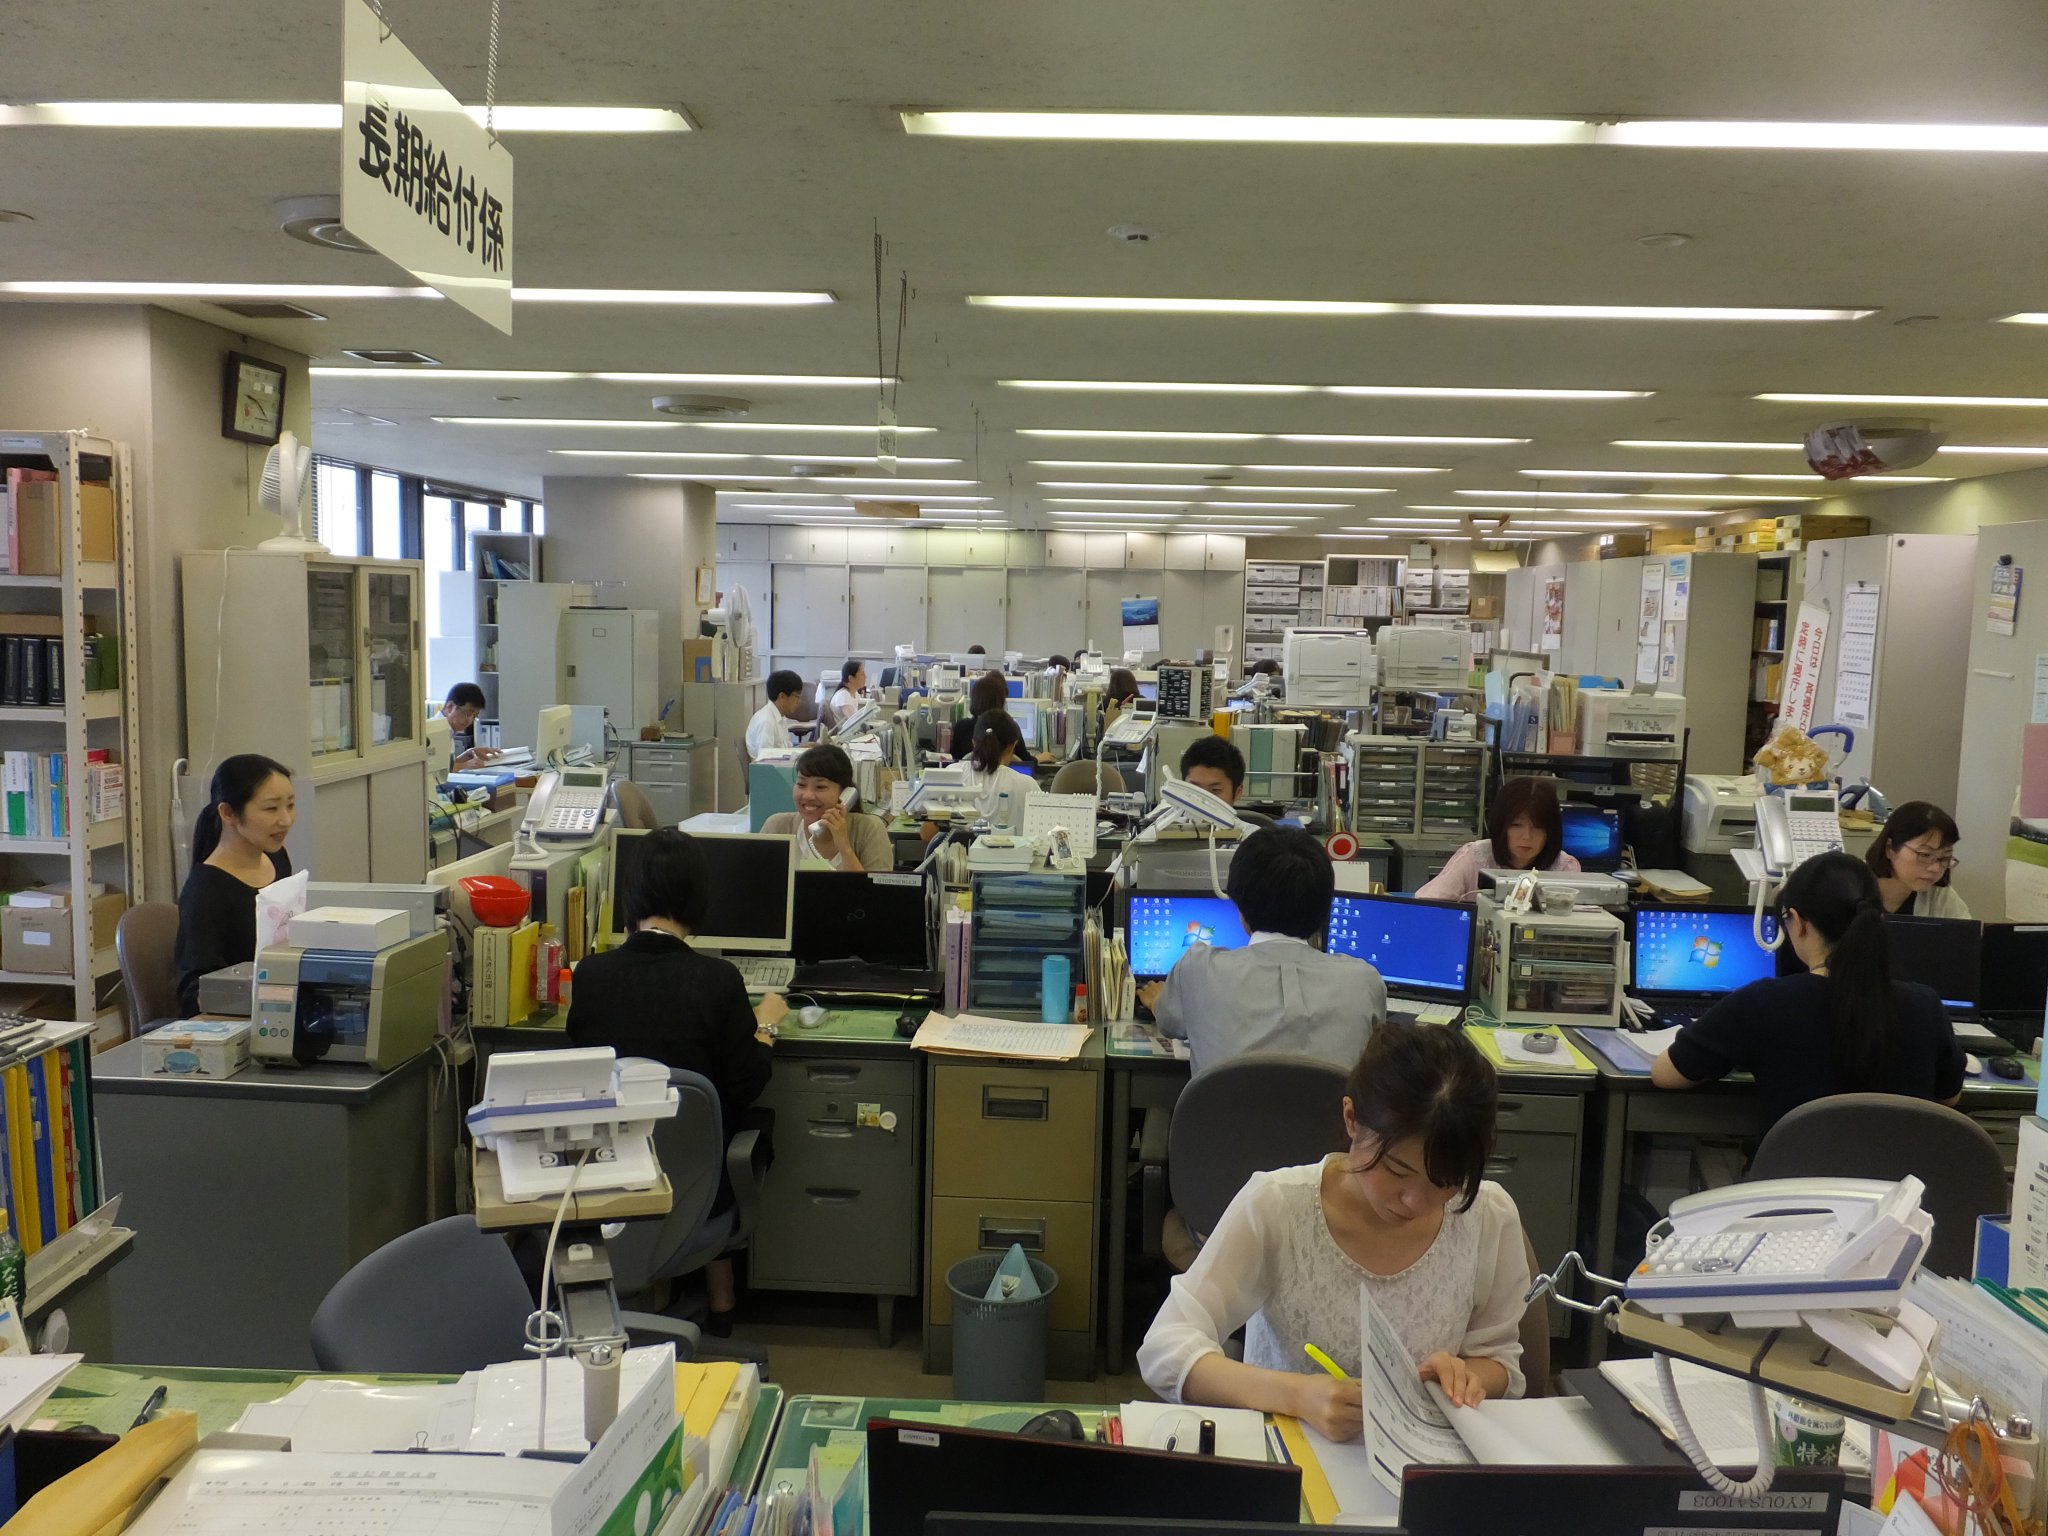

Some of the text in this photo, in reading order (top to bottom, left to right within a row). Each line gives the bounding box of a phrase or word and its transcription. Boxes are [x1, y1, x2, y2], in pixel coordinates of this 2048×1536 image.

[359, 101, 504, 273] 長期給付係
